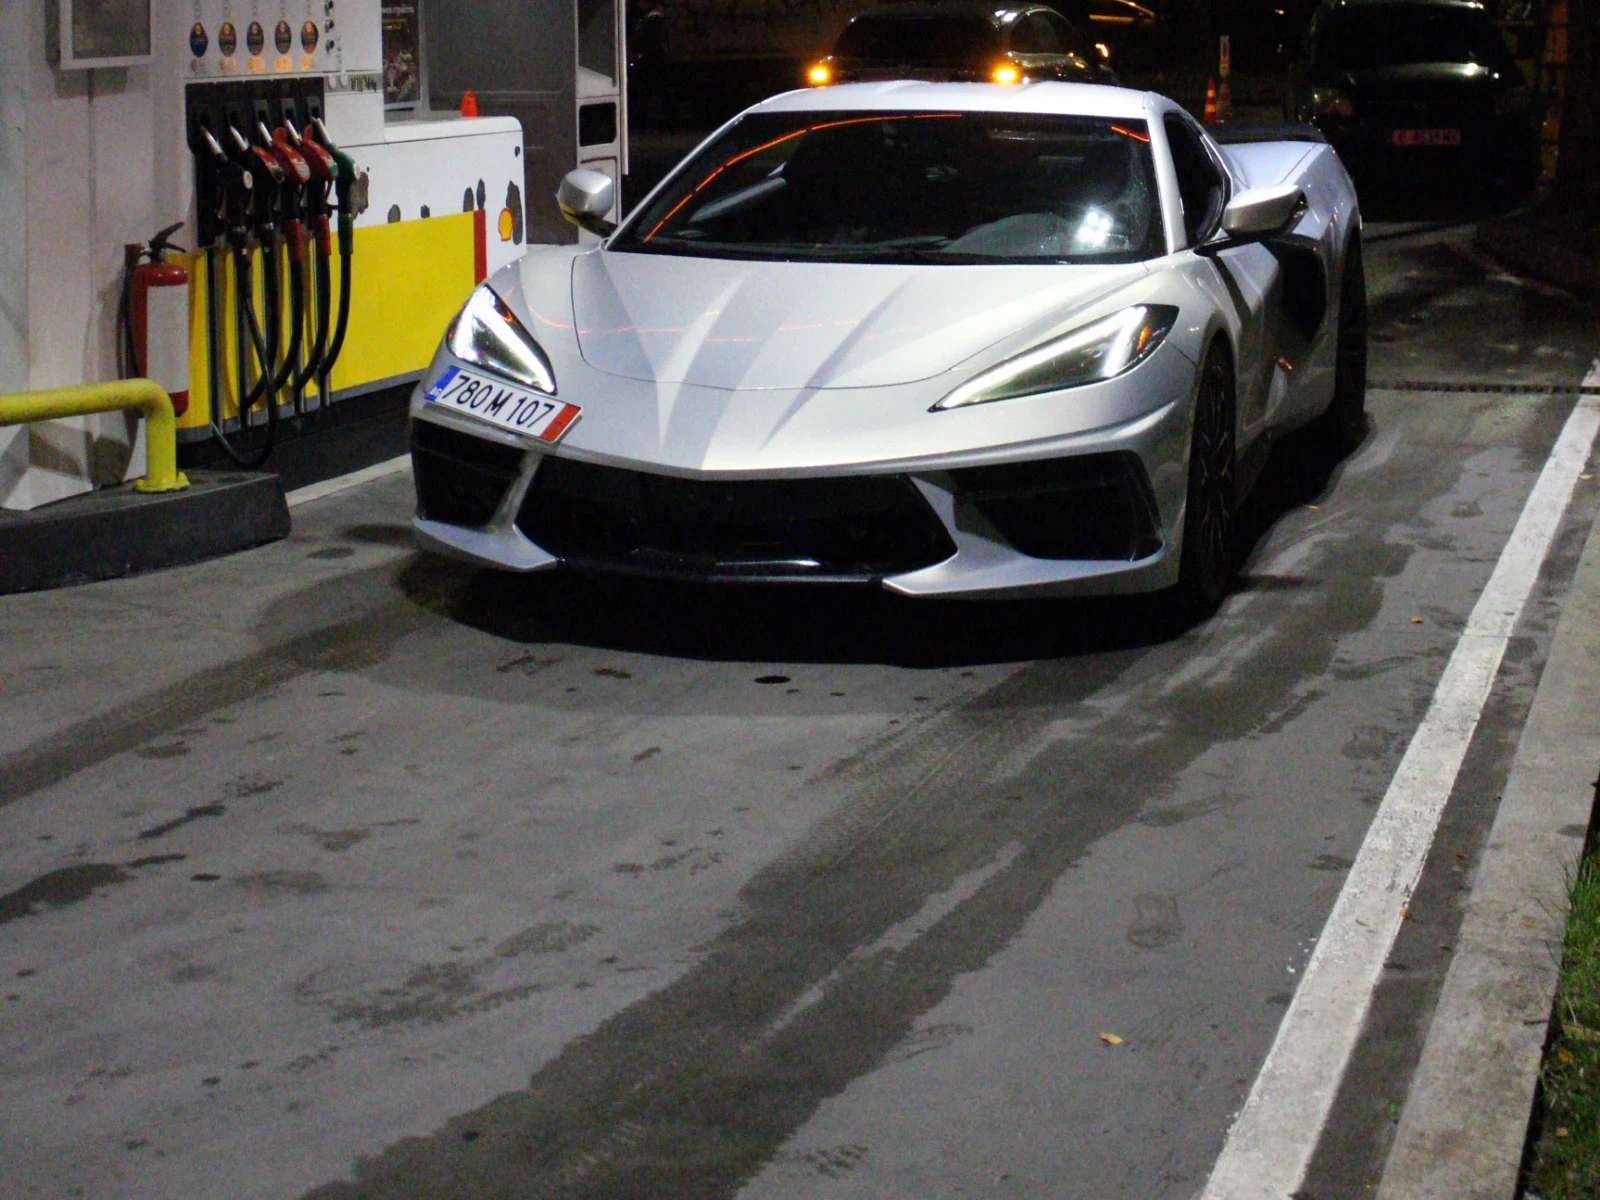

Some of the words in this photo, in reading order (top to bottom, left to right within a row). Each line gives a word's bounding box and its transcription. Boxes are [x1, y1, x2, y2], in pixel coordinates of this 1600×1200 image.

[442, 375, 492, 409] 780
[484, 389, 513, 417] M
[506, 397, 555, 428] 107
